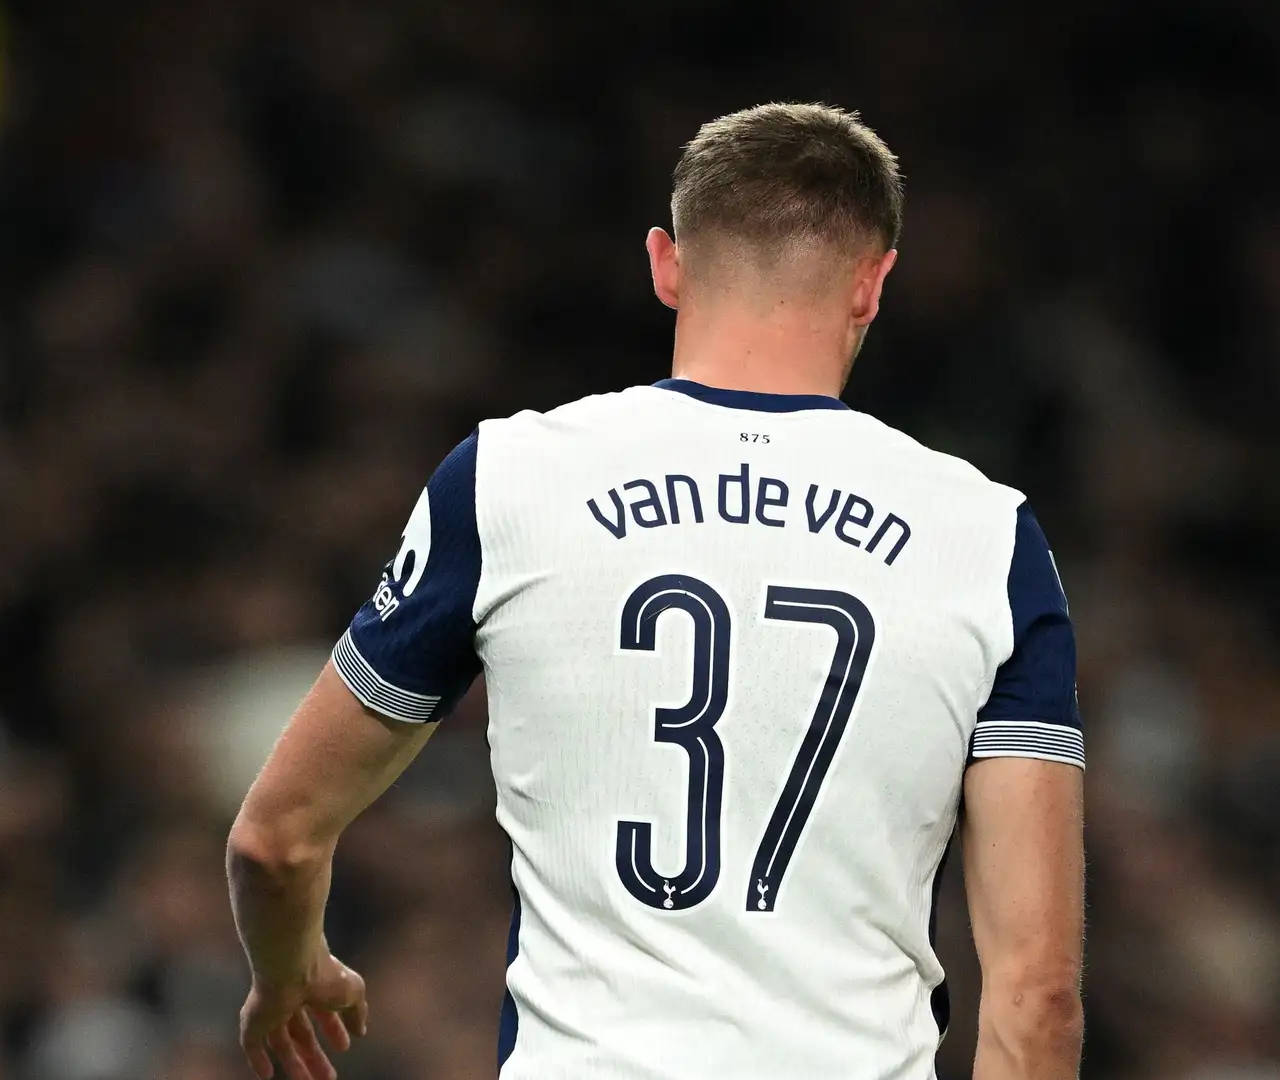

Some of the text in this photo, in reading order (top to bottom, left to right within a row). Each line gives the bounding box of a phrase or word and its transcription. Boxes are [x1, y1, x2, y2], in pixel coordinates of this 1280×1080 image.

[739, 432, 771, 444] 875
[586, 463, 912, 566] van de ven
[616, 574, 876, 912] 37
